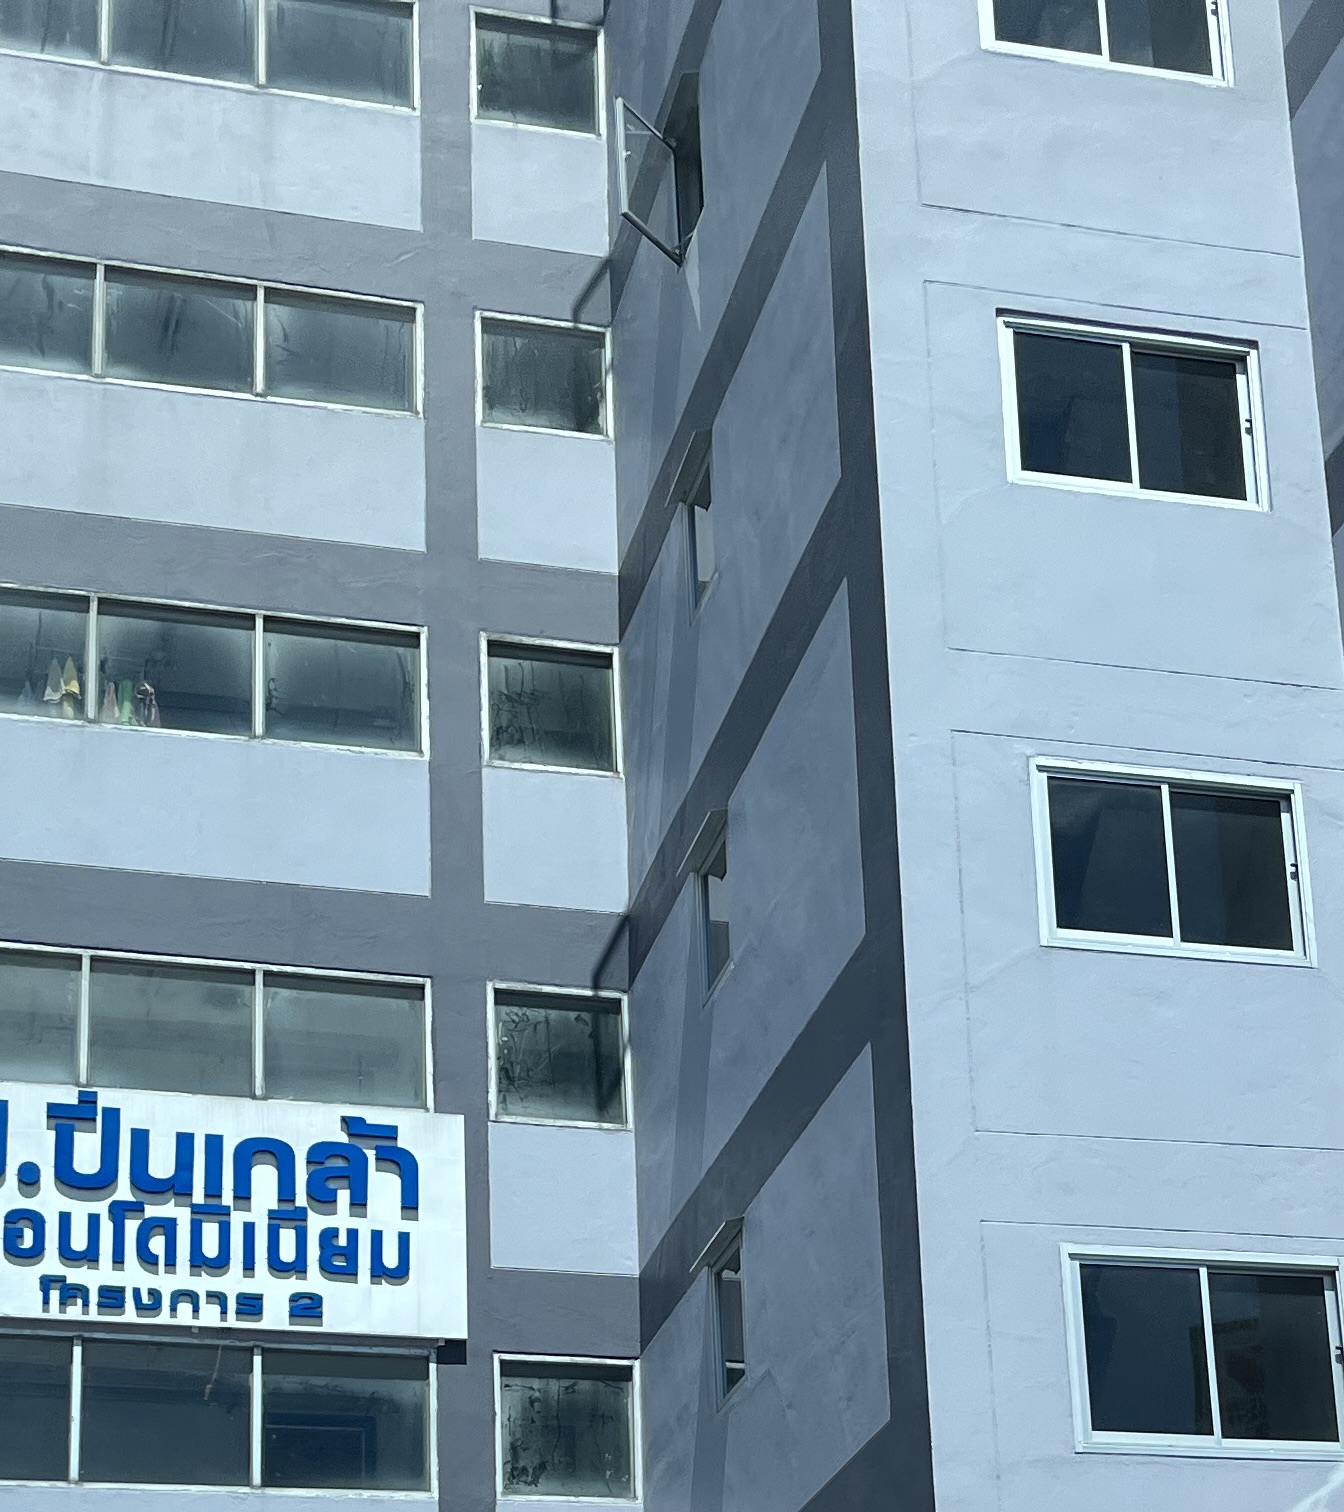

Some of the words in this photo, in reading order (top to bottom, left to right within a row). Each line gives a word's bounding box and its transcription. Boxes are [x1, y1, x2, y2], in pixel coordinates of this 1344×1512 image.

[39, 1274, 263, 1315] โครงการ
[288, 1291, 323, 1318] 2
